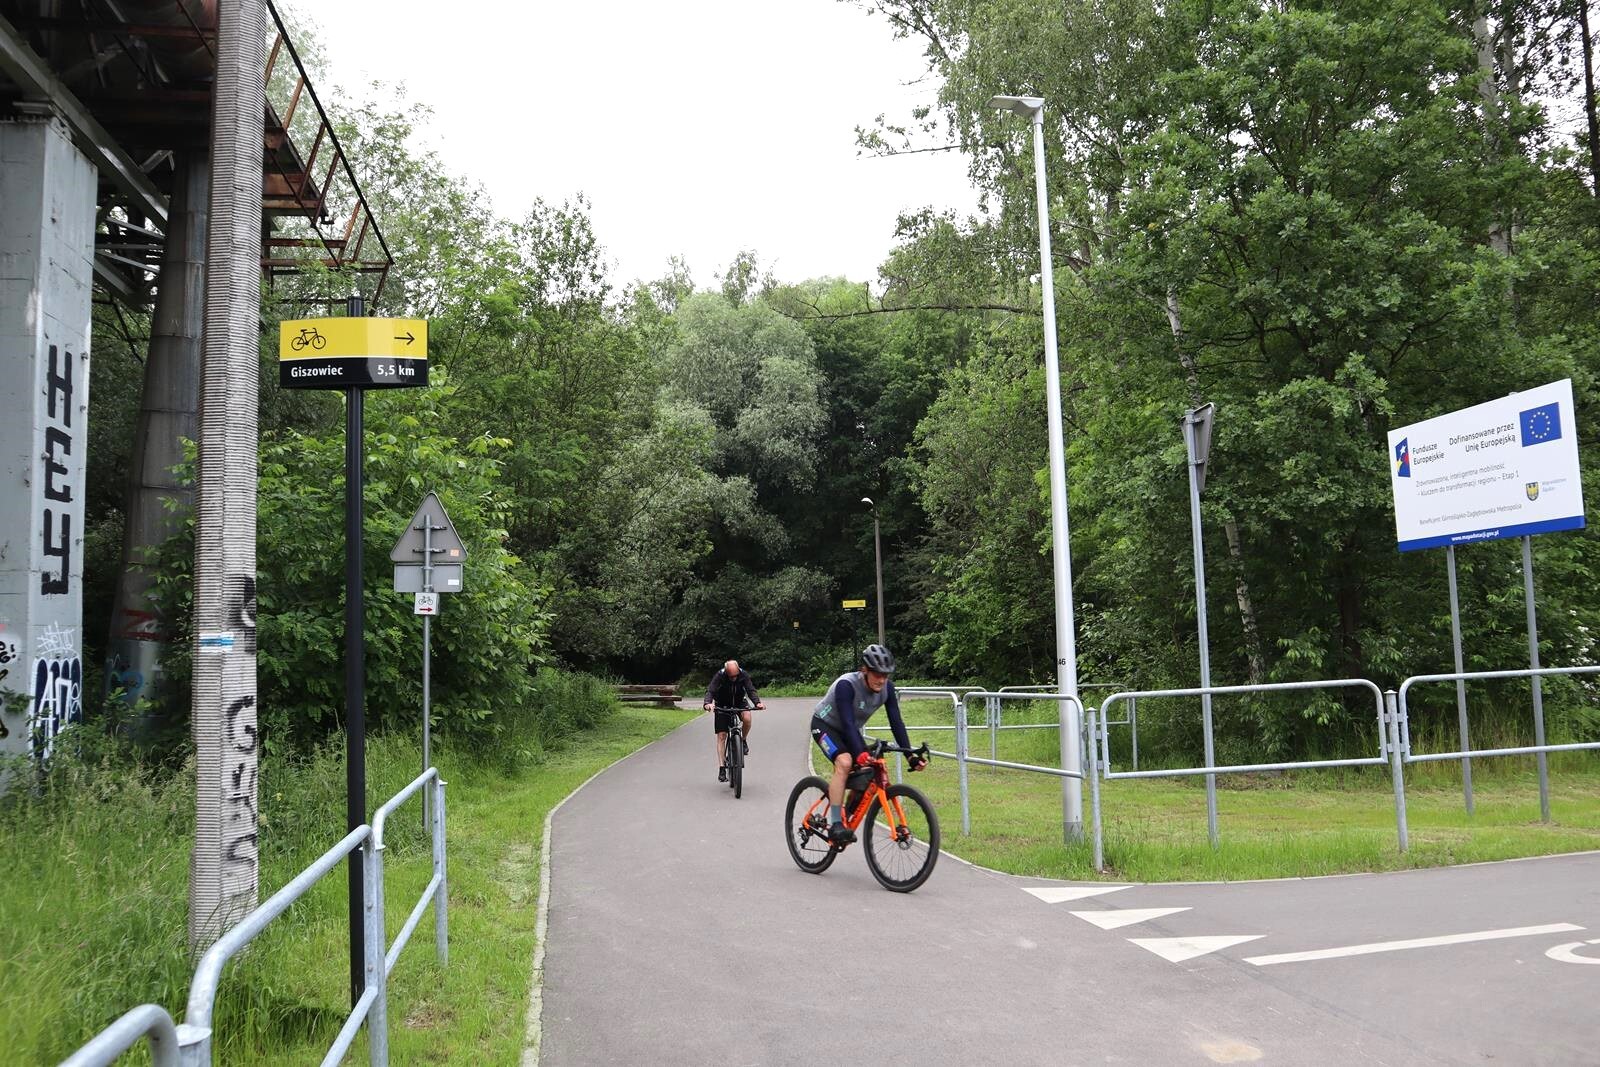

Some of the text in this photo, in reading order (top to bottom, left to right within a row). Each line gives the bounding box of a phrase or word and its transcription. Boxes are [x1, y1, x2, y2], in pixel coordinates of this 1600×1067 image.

[291, 364, 415, 378] Giszowiec 5,5 km
[1449, 422, 1515, 445] Dofinansowane przez
[1412, 442, 1438, 454] Fundusze
[1465, 434, 1516, 453] Unię Europejską
[1413, 452, 1445, 465] Europejskie
[1501, 472, 1514, 481] Etap
